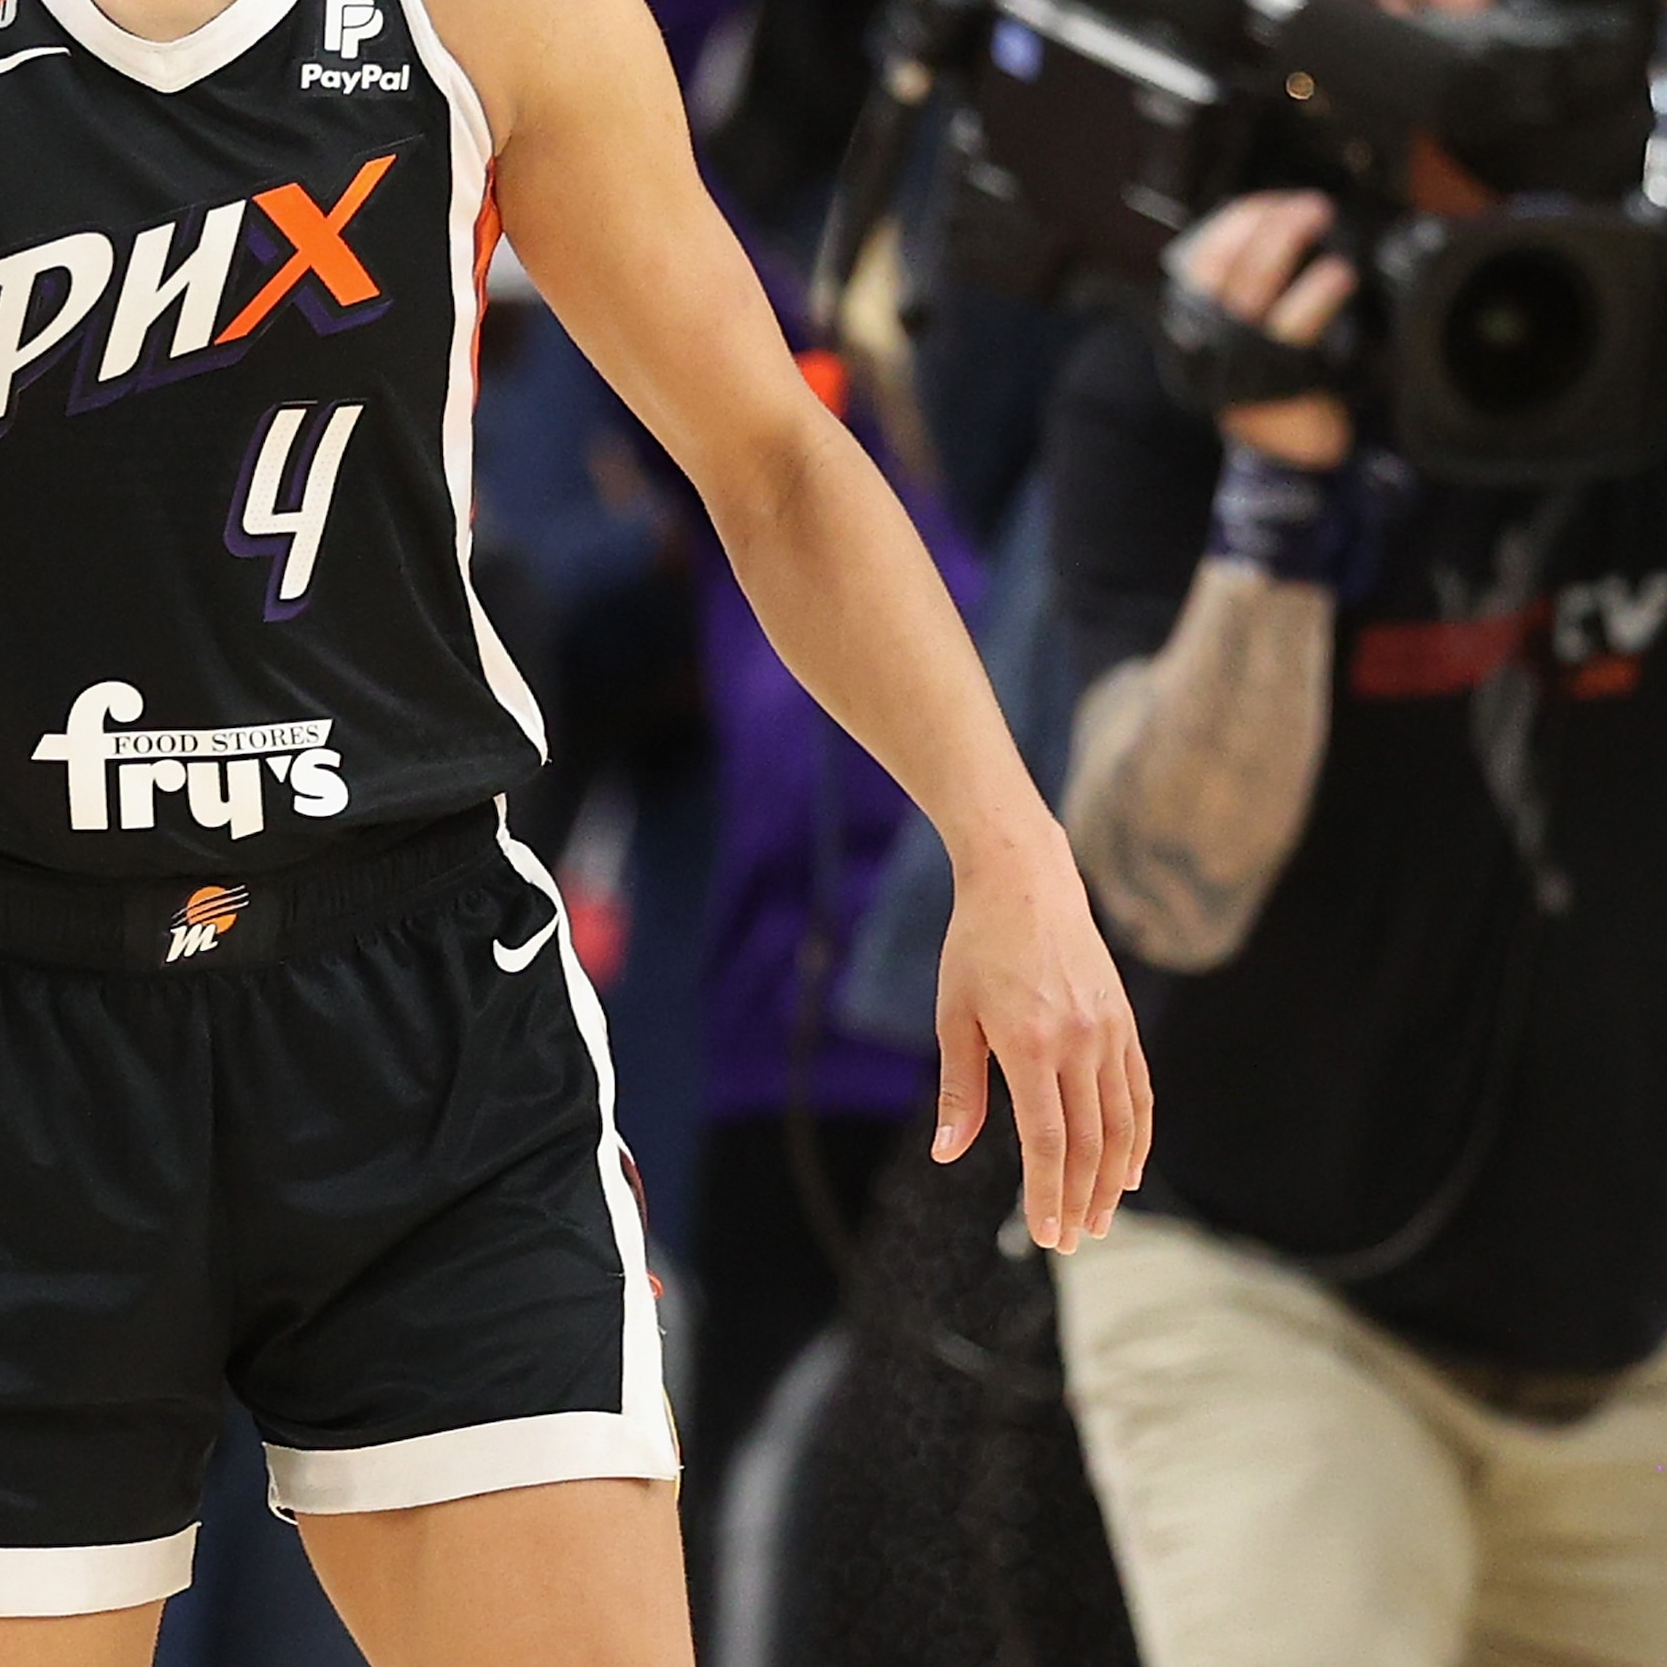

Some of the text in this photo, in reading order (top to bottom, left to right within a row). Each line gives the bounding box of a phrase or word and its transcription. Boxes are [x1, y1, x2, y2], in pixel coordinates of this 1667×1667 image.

[300, 63, 411, 95] PayPal
[241, 404, 365, 602] 4
[31, 680, 349, 841] fry's
[113, 723, 320, 756] FOOD STORES
